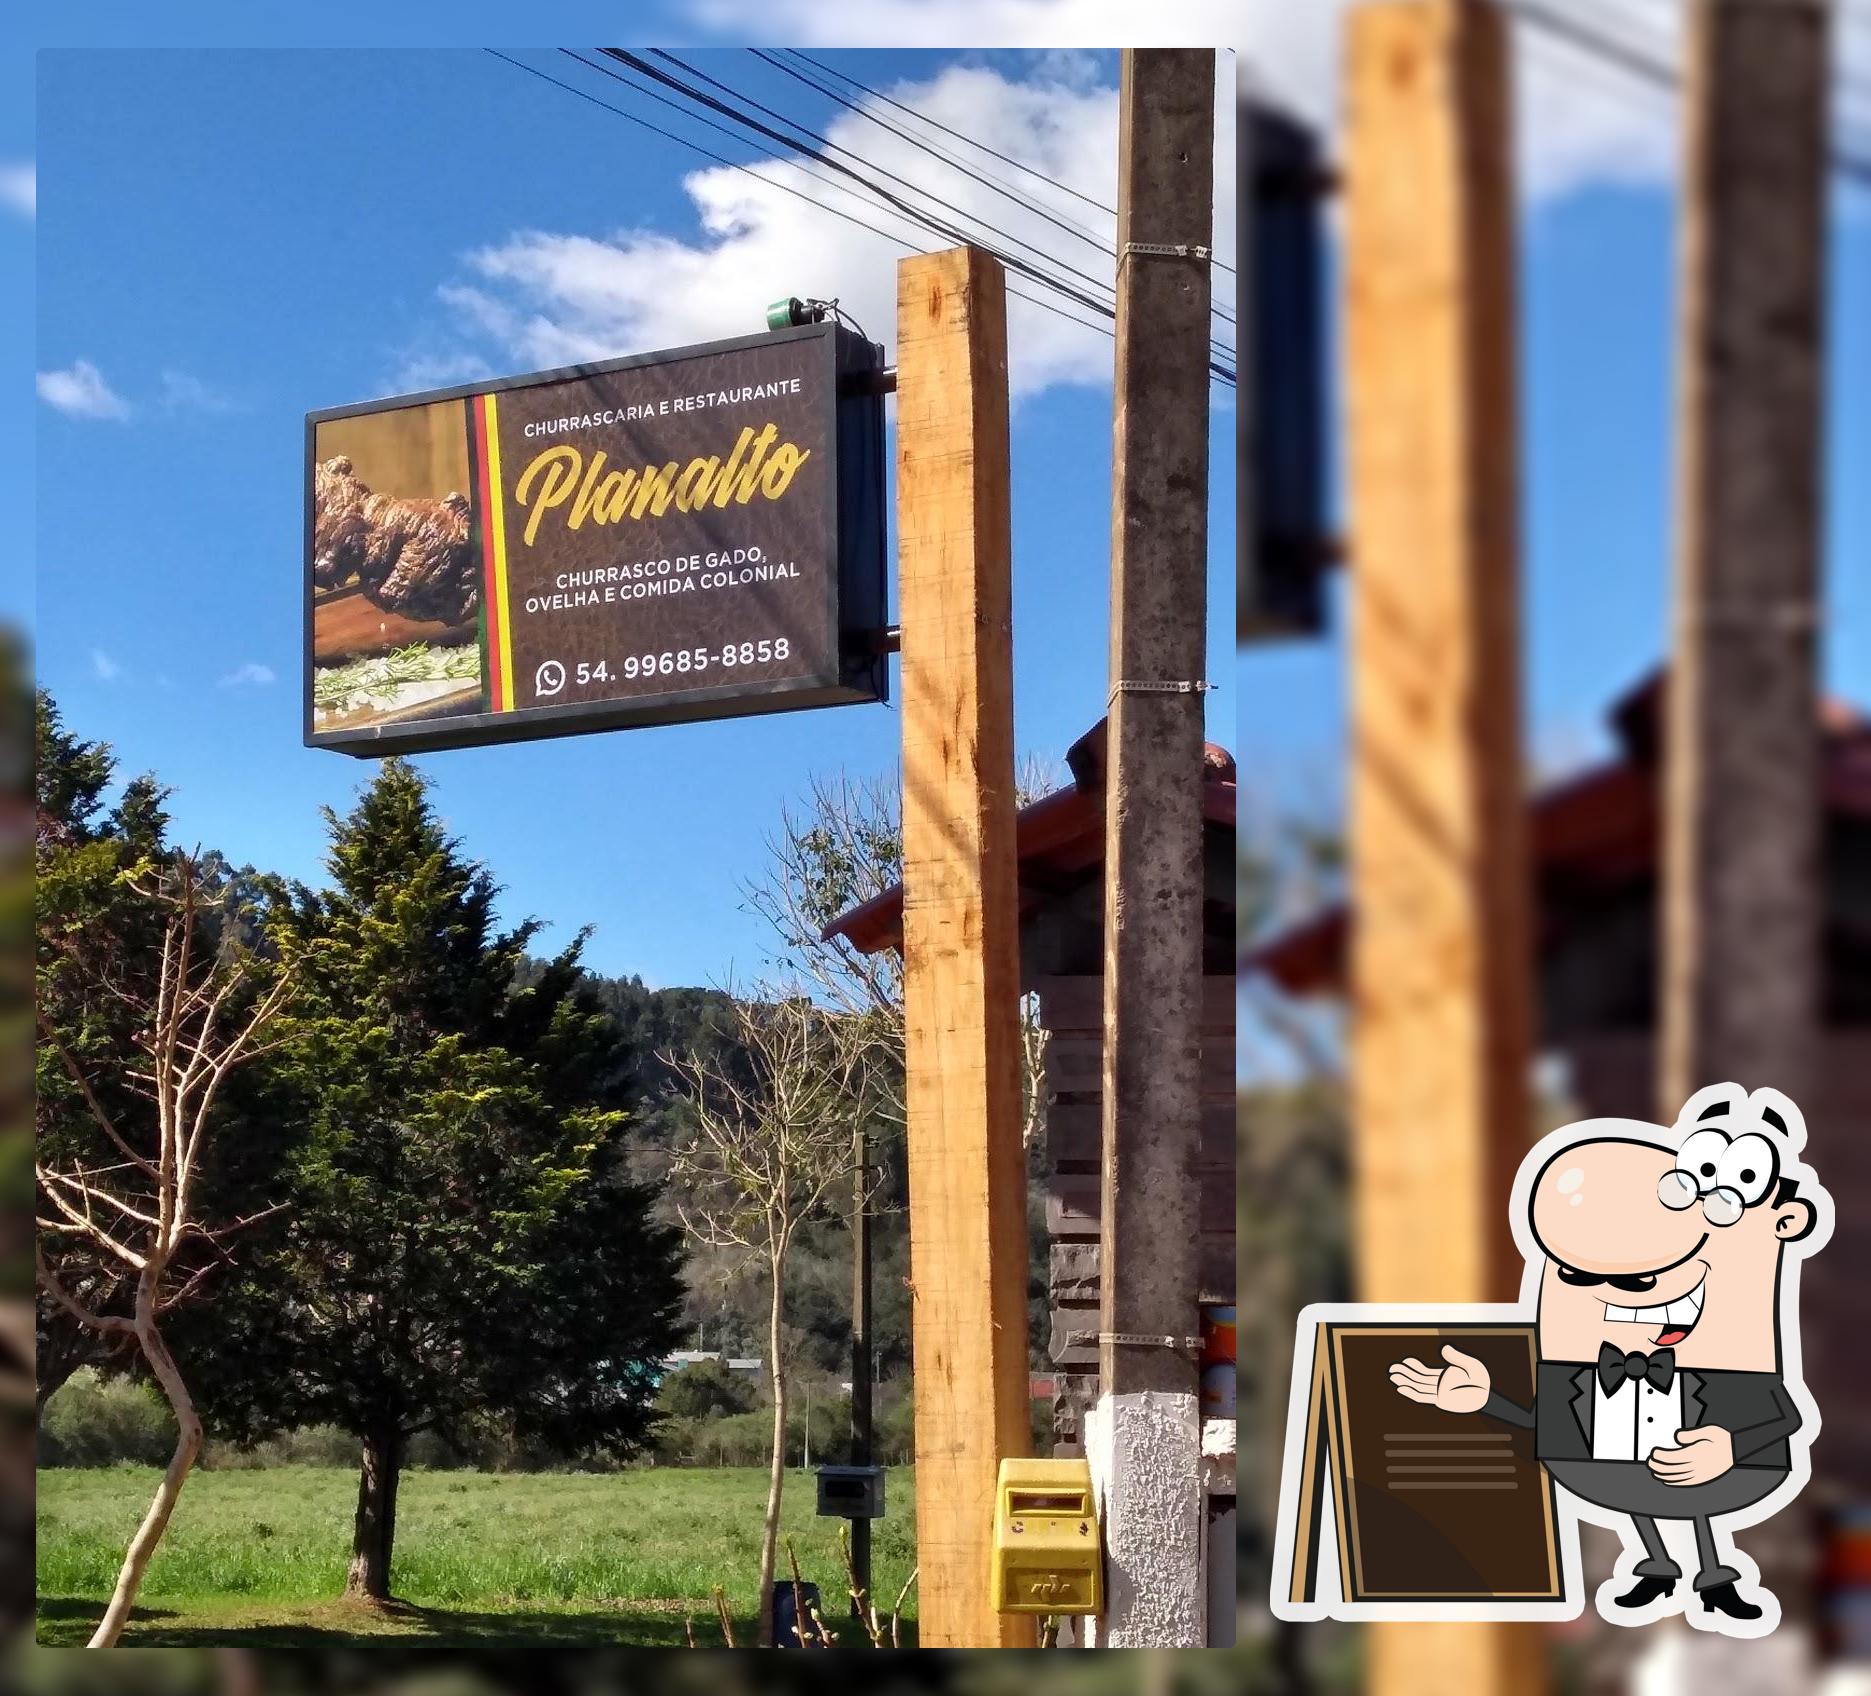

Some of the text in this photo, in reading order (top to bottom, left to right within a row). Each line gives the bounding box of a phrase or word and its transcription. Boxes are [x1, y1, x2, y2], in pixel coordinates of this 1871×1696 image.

[524, 378, 801, 438] CHURRASCARIA E RESTAURANTE
[515, 423, 811, 547] Planalto
[525, 561, 801, 613] OVELHA E COMIDA COLONIAL
[556, 546, 767, 589] CHURRASCO DE GADO,
[576, 637, 790, 685] 54. 99685-8858
